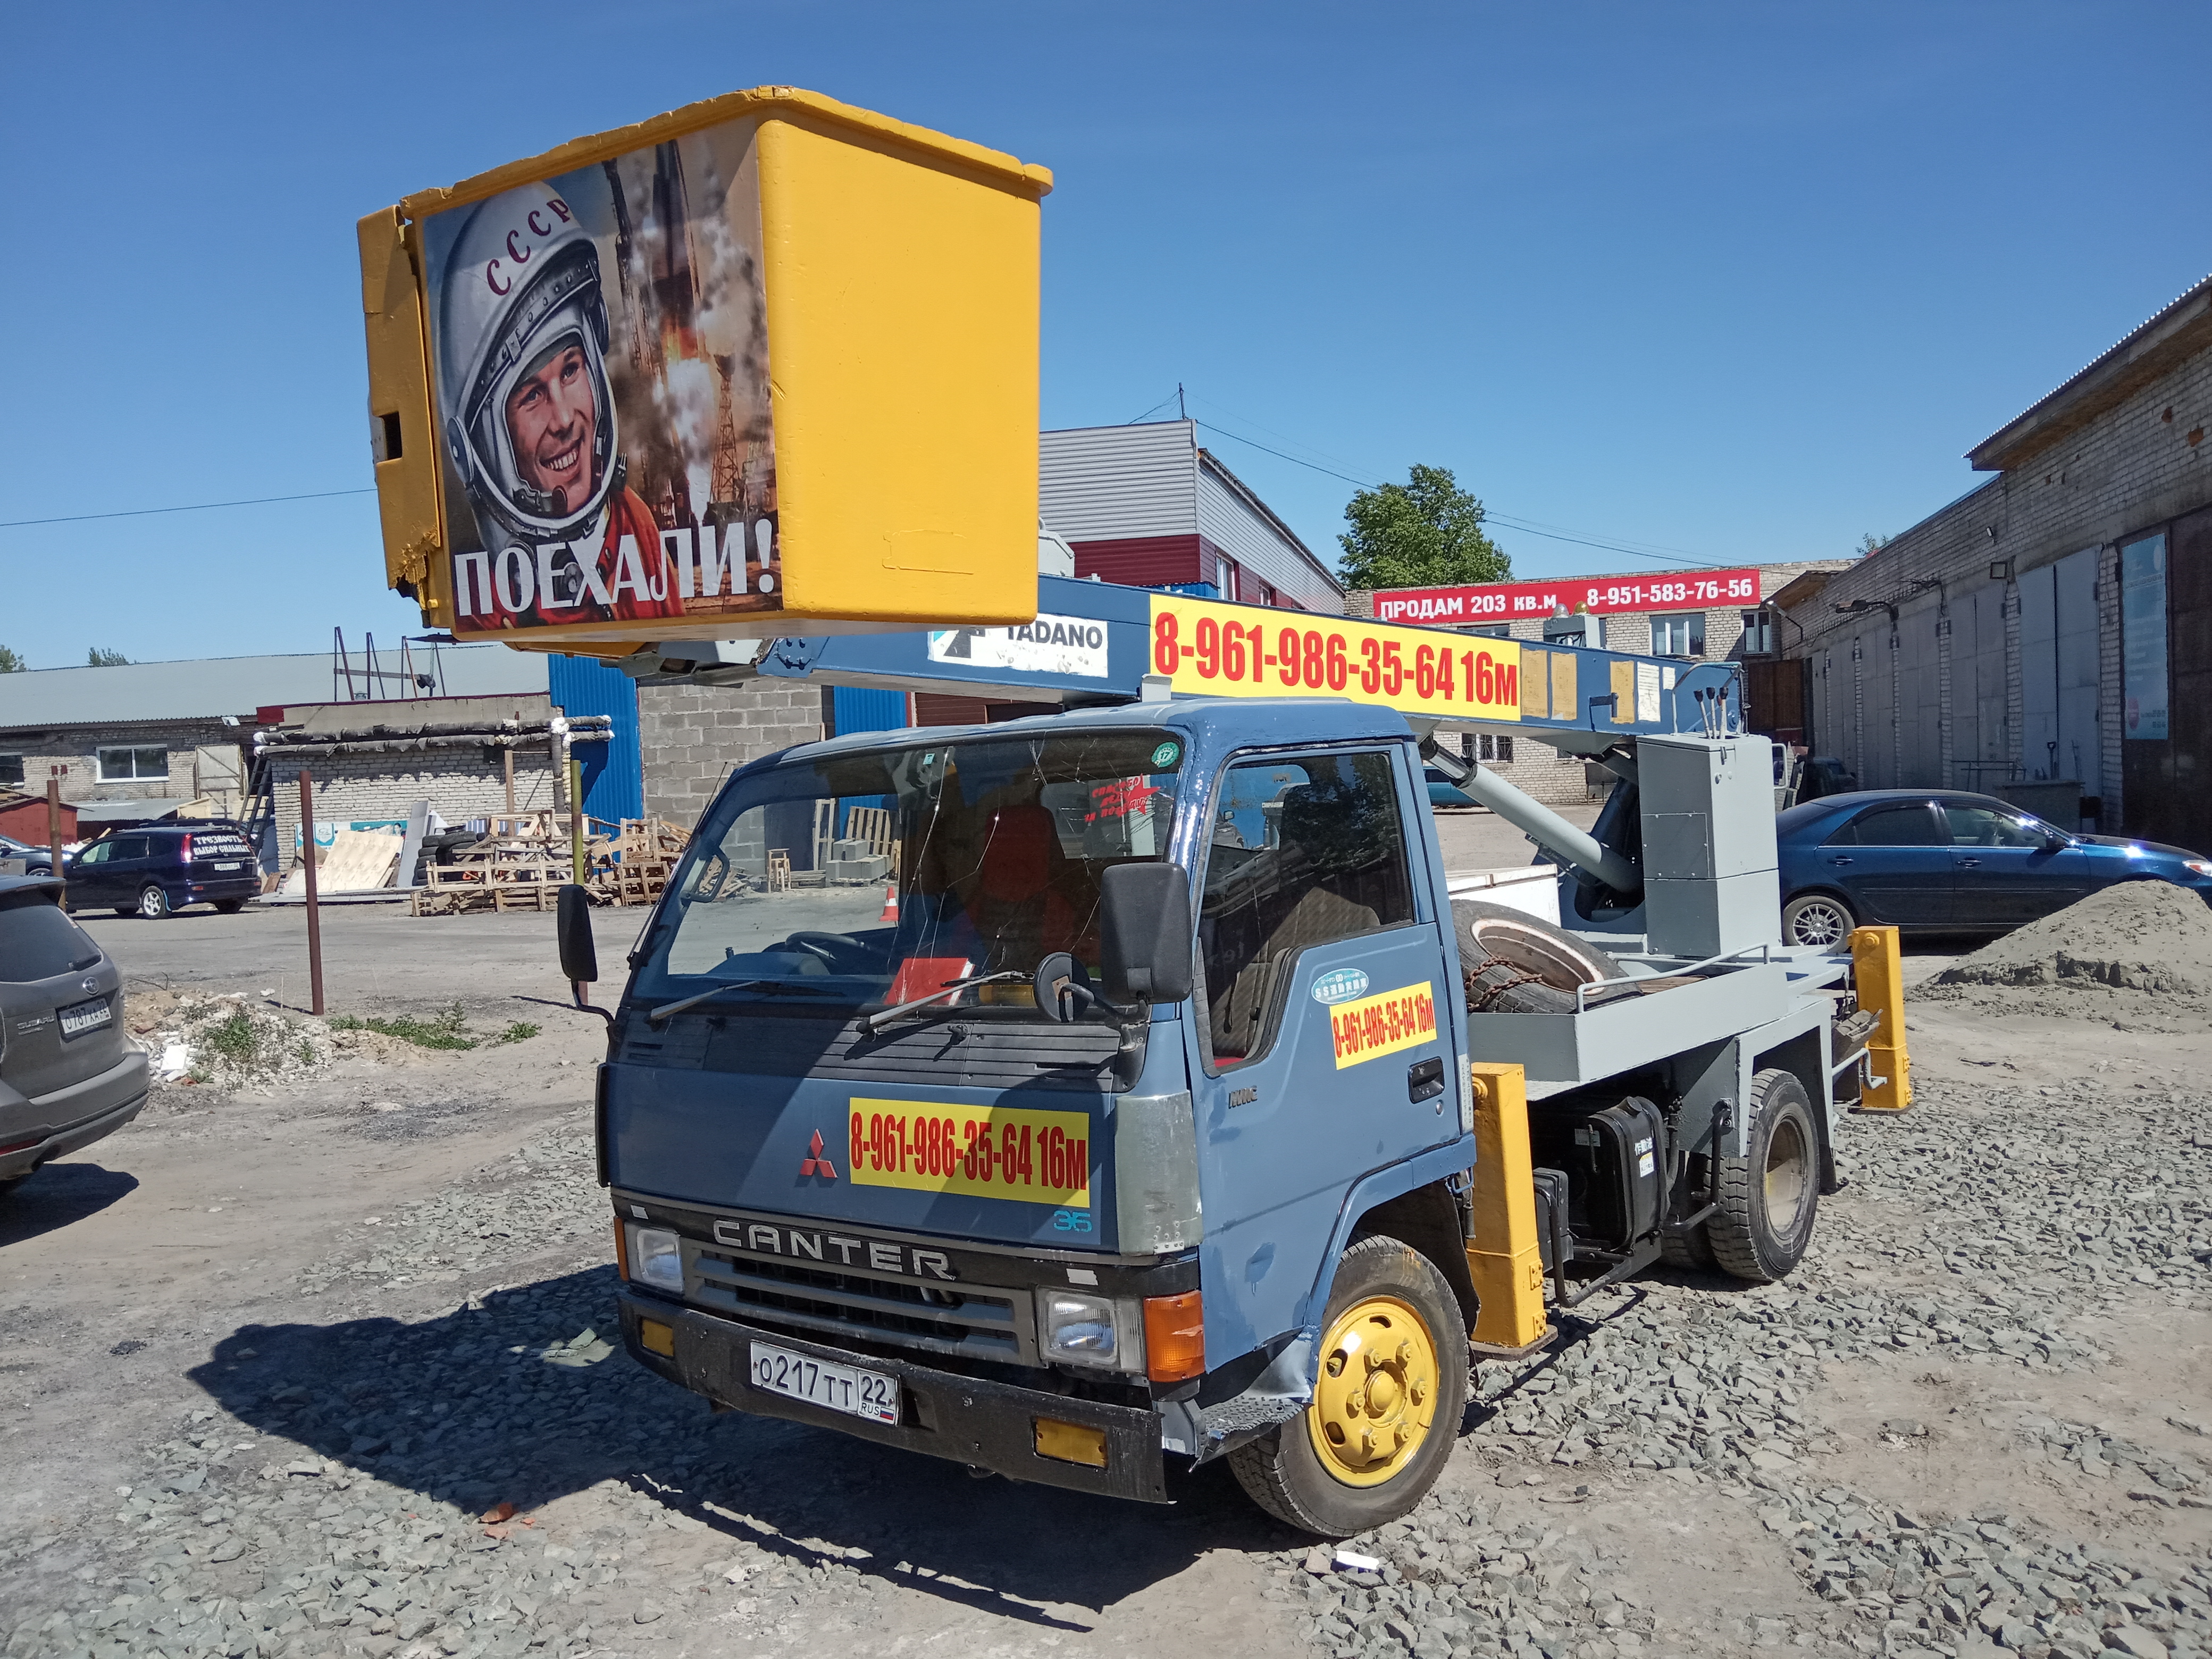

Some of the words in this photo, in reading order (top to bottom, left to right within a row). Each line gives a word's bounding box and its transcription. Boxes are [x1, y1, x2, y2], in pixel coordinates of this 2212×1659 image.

[486, 198, 569, 297] СССР
[454, 518, 775, 616] ПОЕХАЛИ!
[1381, 596, 1463, 620] ПРОДАМ
[1470, 594, 1506, 614] 203
[1587, 578, 1753, 607] 8-951-583-76-56
[1155, 611, 1454, 700] 8-961-986-35-64
[193, 845, 218, 856] ВЫБОР
[1333, 996, 1416, 1058] 8-961-986-35-64
[851, 1112, 1033, 1185] 8-961-986-35-64
[713, 1220, 957, 1281] CANTER
[1053, 1210, 1092, 1232] 35
[861, 1403, 879, 1415] RUS
[862, 1375, 887, 1406] 22
